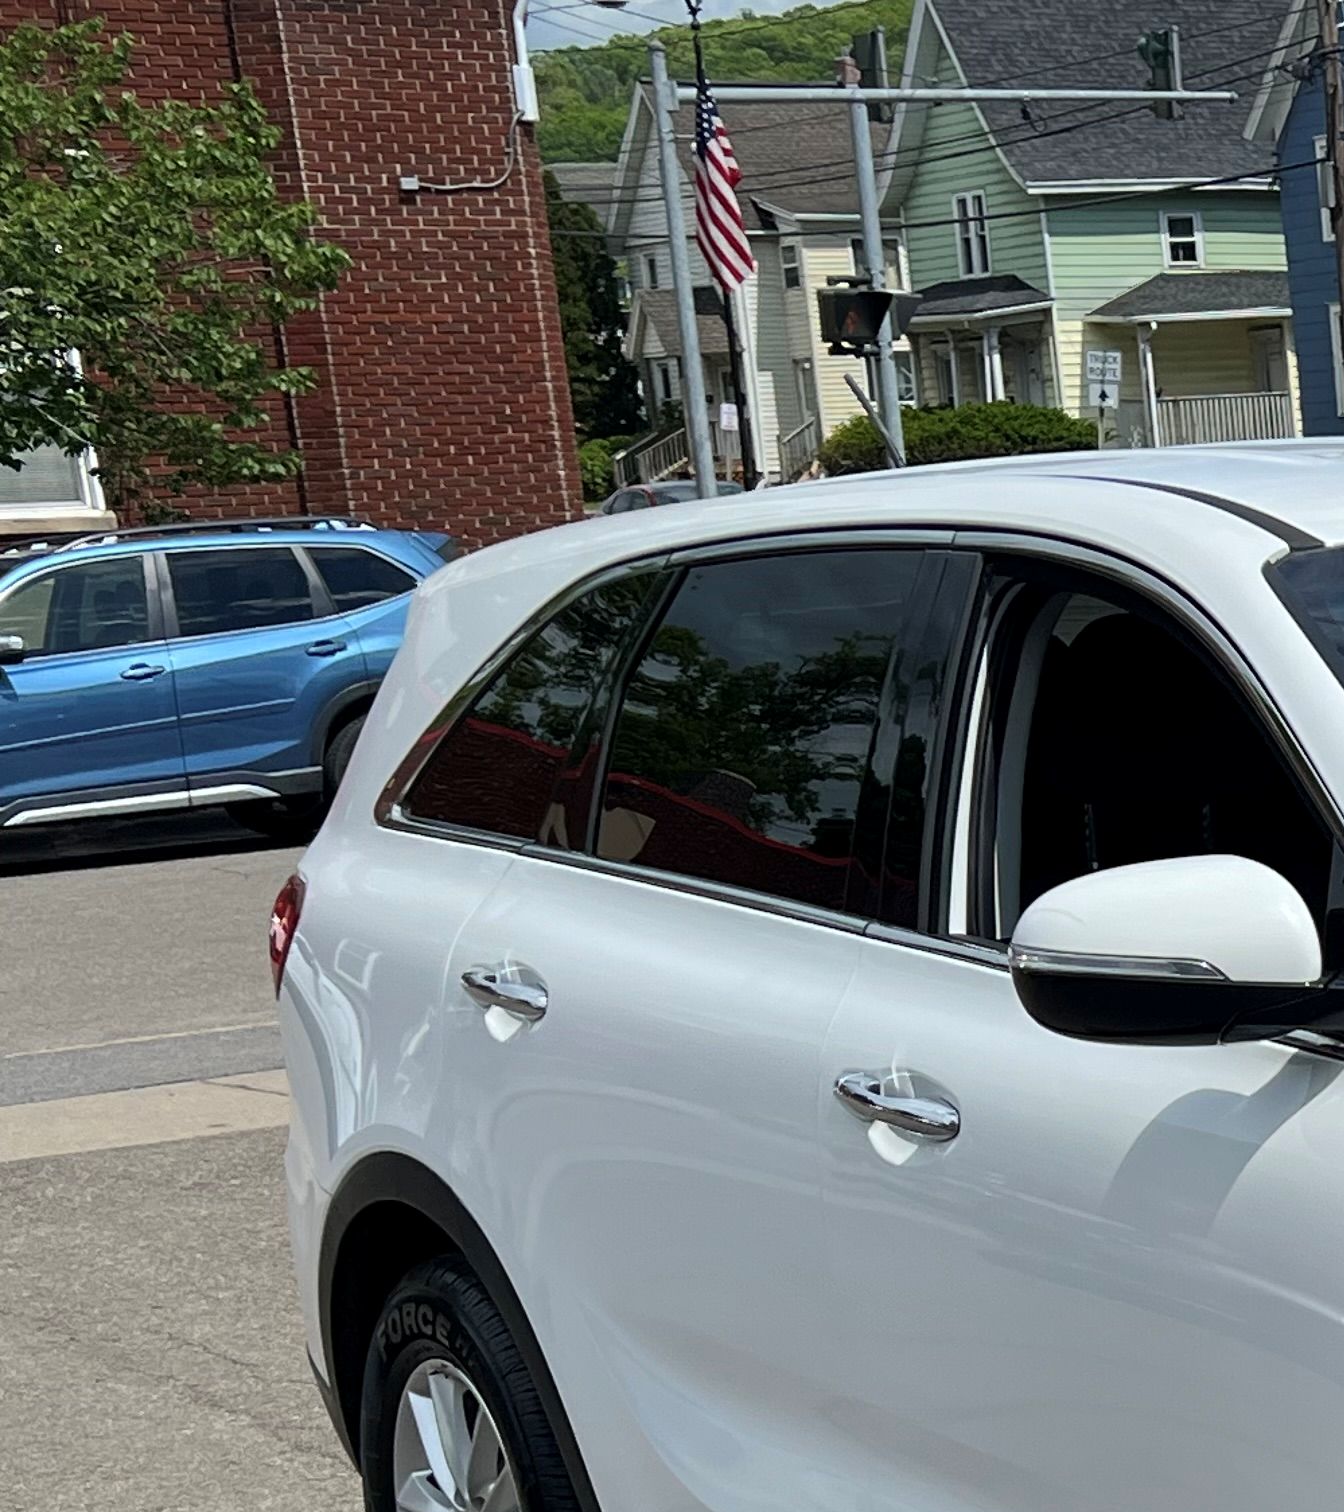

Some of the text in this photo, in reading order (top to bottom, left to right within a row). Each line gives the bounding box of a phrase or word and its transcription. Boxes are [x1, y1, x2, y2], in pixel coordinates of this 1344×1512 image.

[1090, 354, 1119, 364] TRUCK
[1090, 366, 1118, 378] ROUTE
[377, 1301, 451, 1363] FORCE
